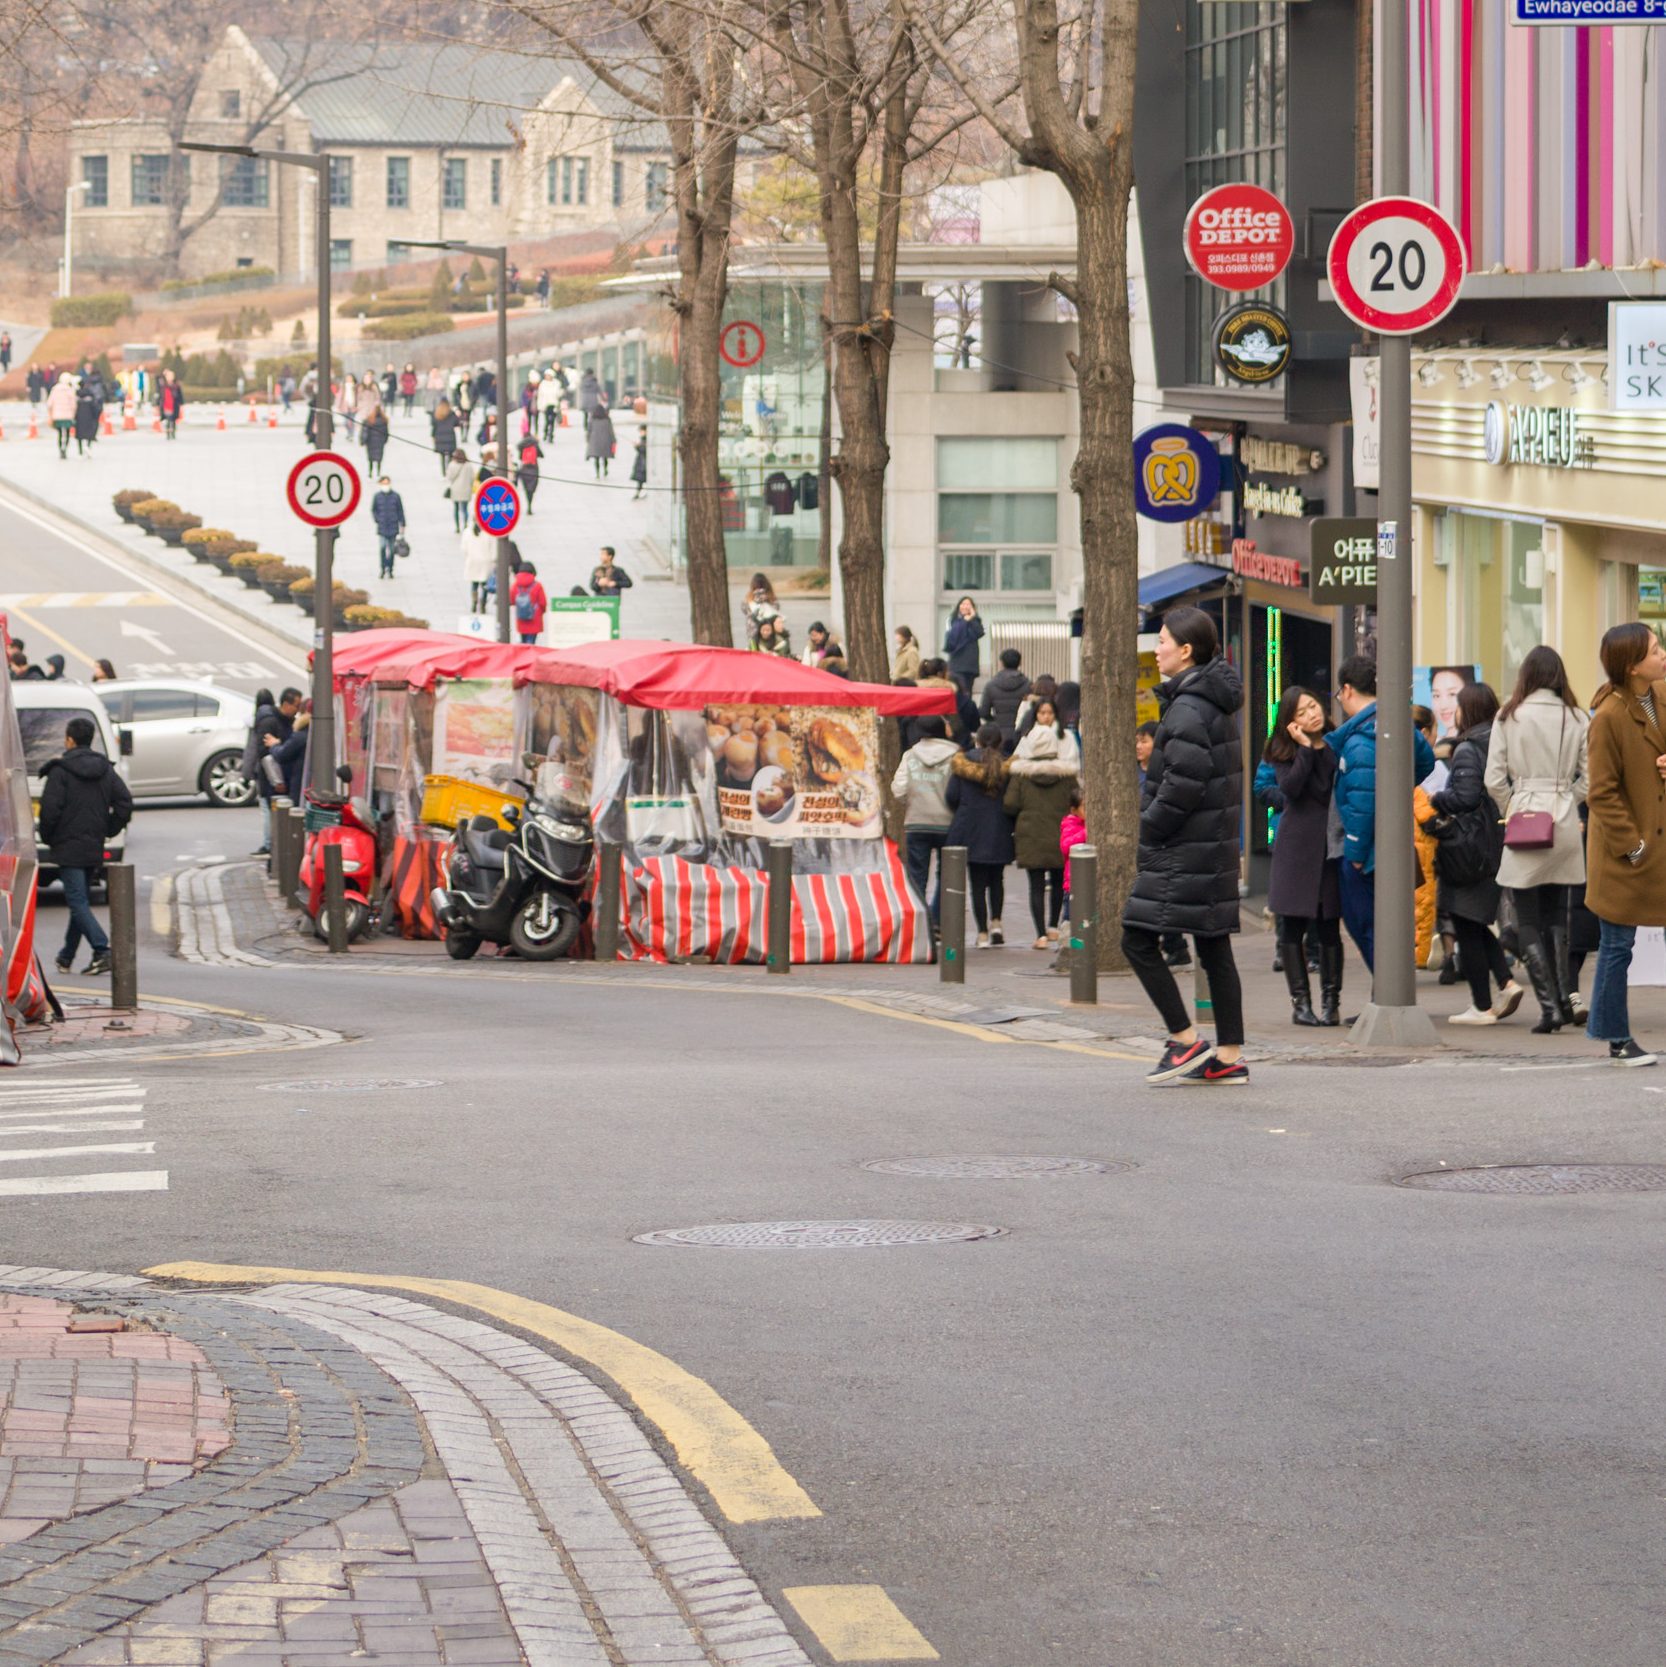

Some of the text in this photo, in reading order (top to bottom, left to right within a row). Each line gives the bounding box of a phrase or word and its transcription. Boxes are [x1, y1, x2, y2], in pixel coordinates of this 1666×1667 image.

[1198, 207, 1281, 229] Office
[1199, 228, 1281, 245] DEPOT
[1207, 252, 1249, 264] 오피스디포
[1207, 262, 1275, 275] 393.0989/0949
[1369, 238, 1426, 292] 20
[303, 472, 345, 505] 20
[1334, 537, 1376, 563] 어퓨
[1232, 538, 1302, 587] Office DEPOT
[802, 795, 842, 810] 전설의
